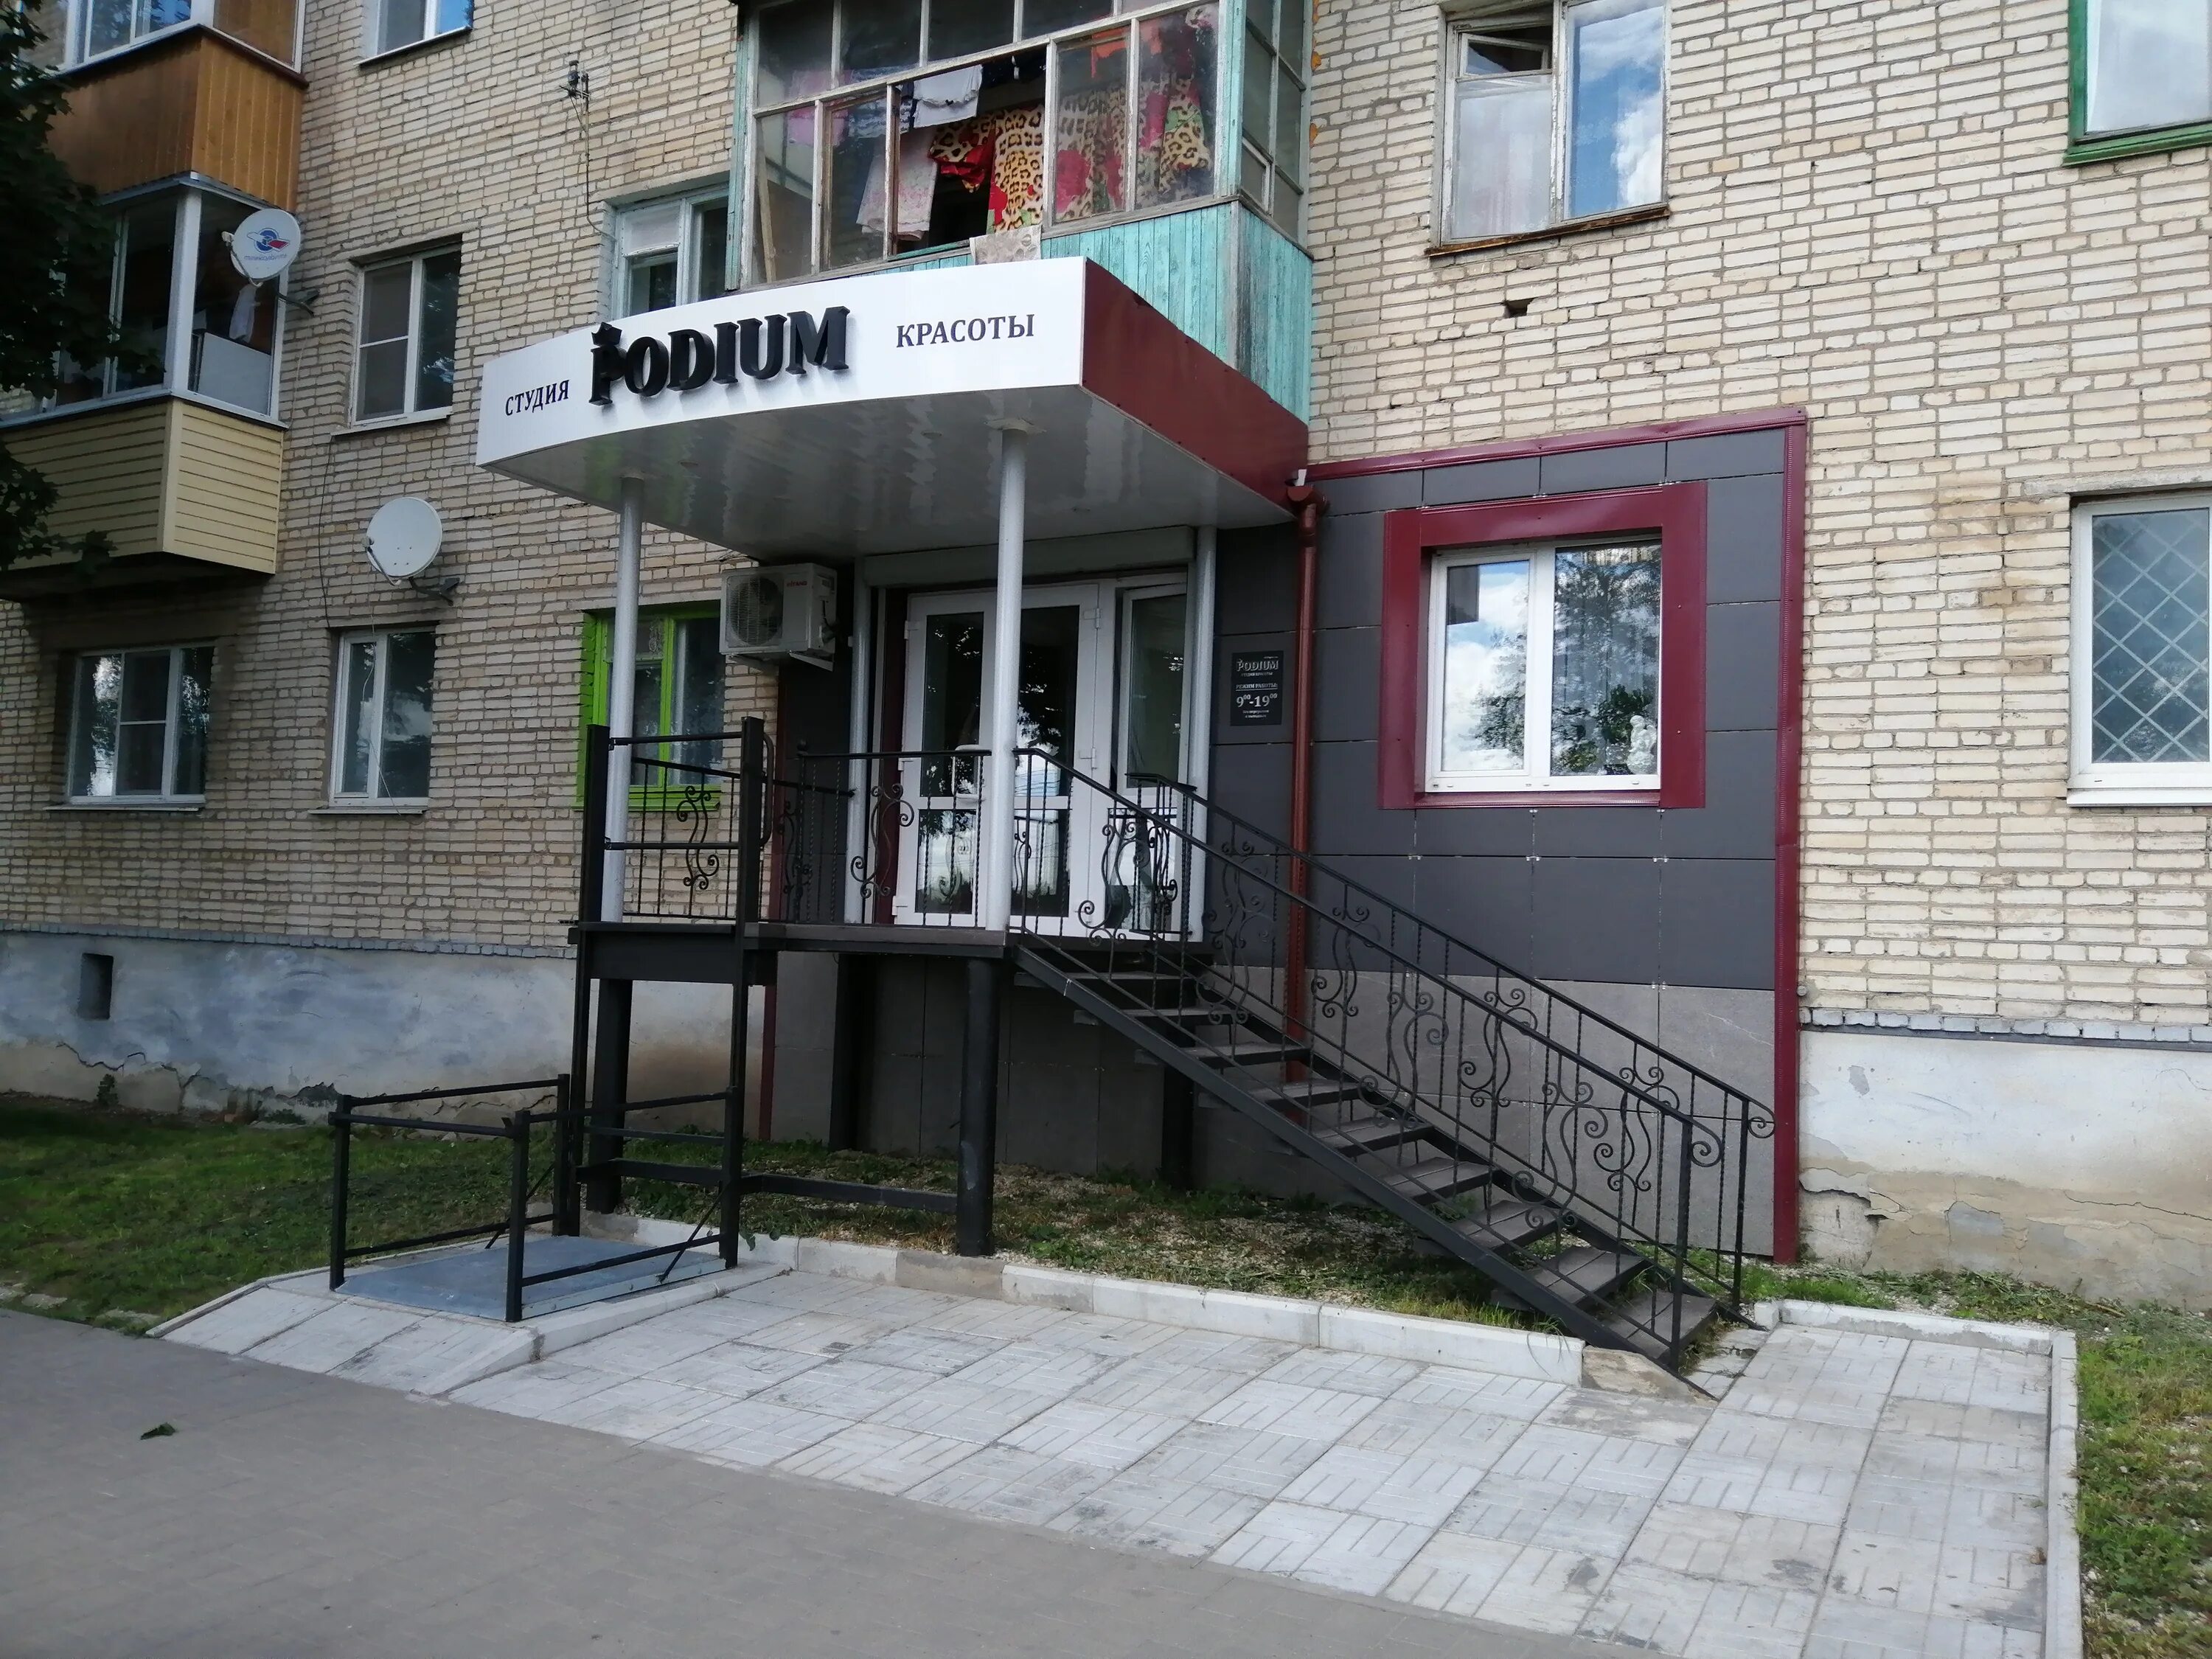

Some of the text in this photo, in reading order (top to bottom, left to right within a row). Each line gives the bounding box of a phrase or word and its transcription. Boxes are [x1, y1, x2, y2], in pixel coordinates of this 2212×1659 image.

[896, 313, 1035, 348] КРАСОТЫ
[589, 306, 851, 406] PODIUM
[505, 379, 570, 417] СТУДИЯ
[1237, 660, 1279, 672] PODIUM
